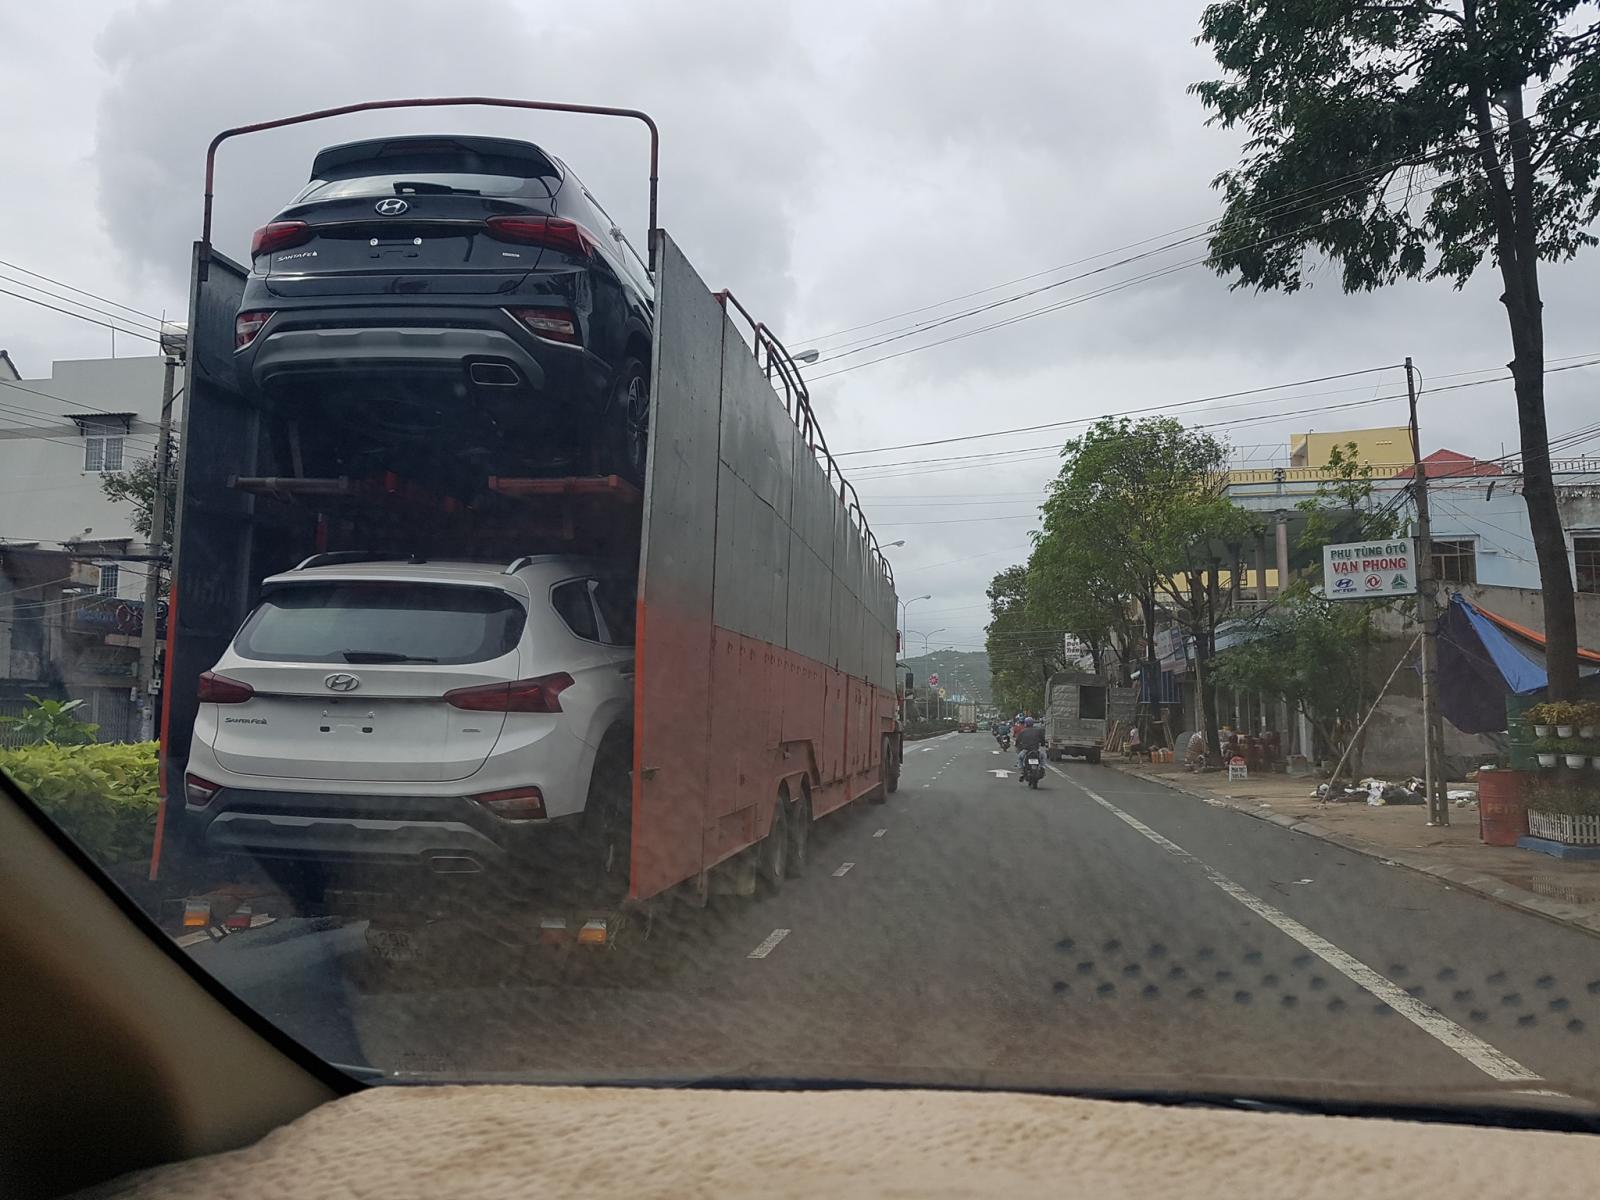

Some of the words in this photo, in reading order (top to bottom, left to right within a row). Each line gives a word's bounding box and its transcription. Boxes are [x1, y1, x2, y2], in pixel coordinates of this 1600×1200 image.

[1330, 549, 1351, 560] PHỤ
[1354, 545, 1382, 557] TÙNG
[1385, 542, 1406, 555] ÔTÔ
[1362, 557, 1406, 572] PHONG
